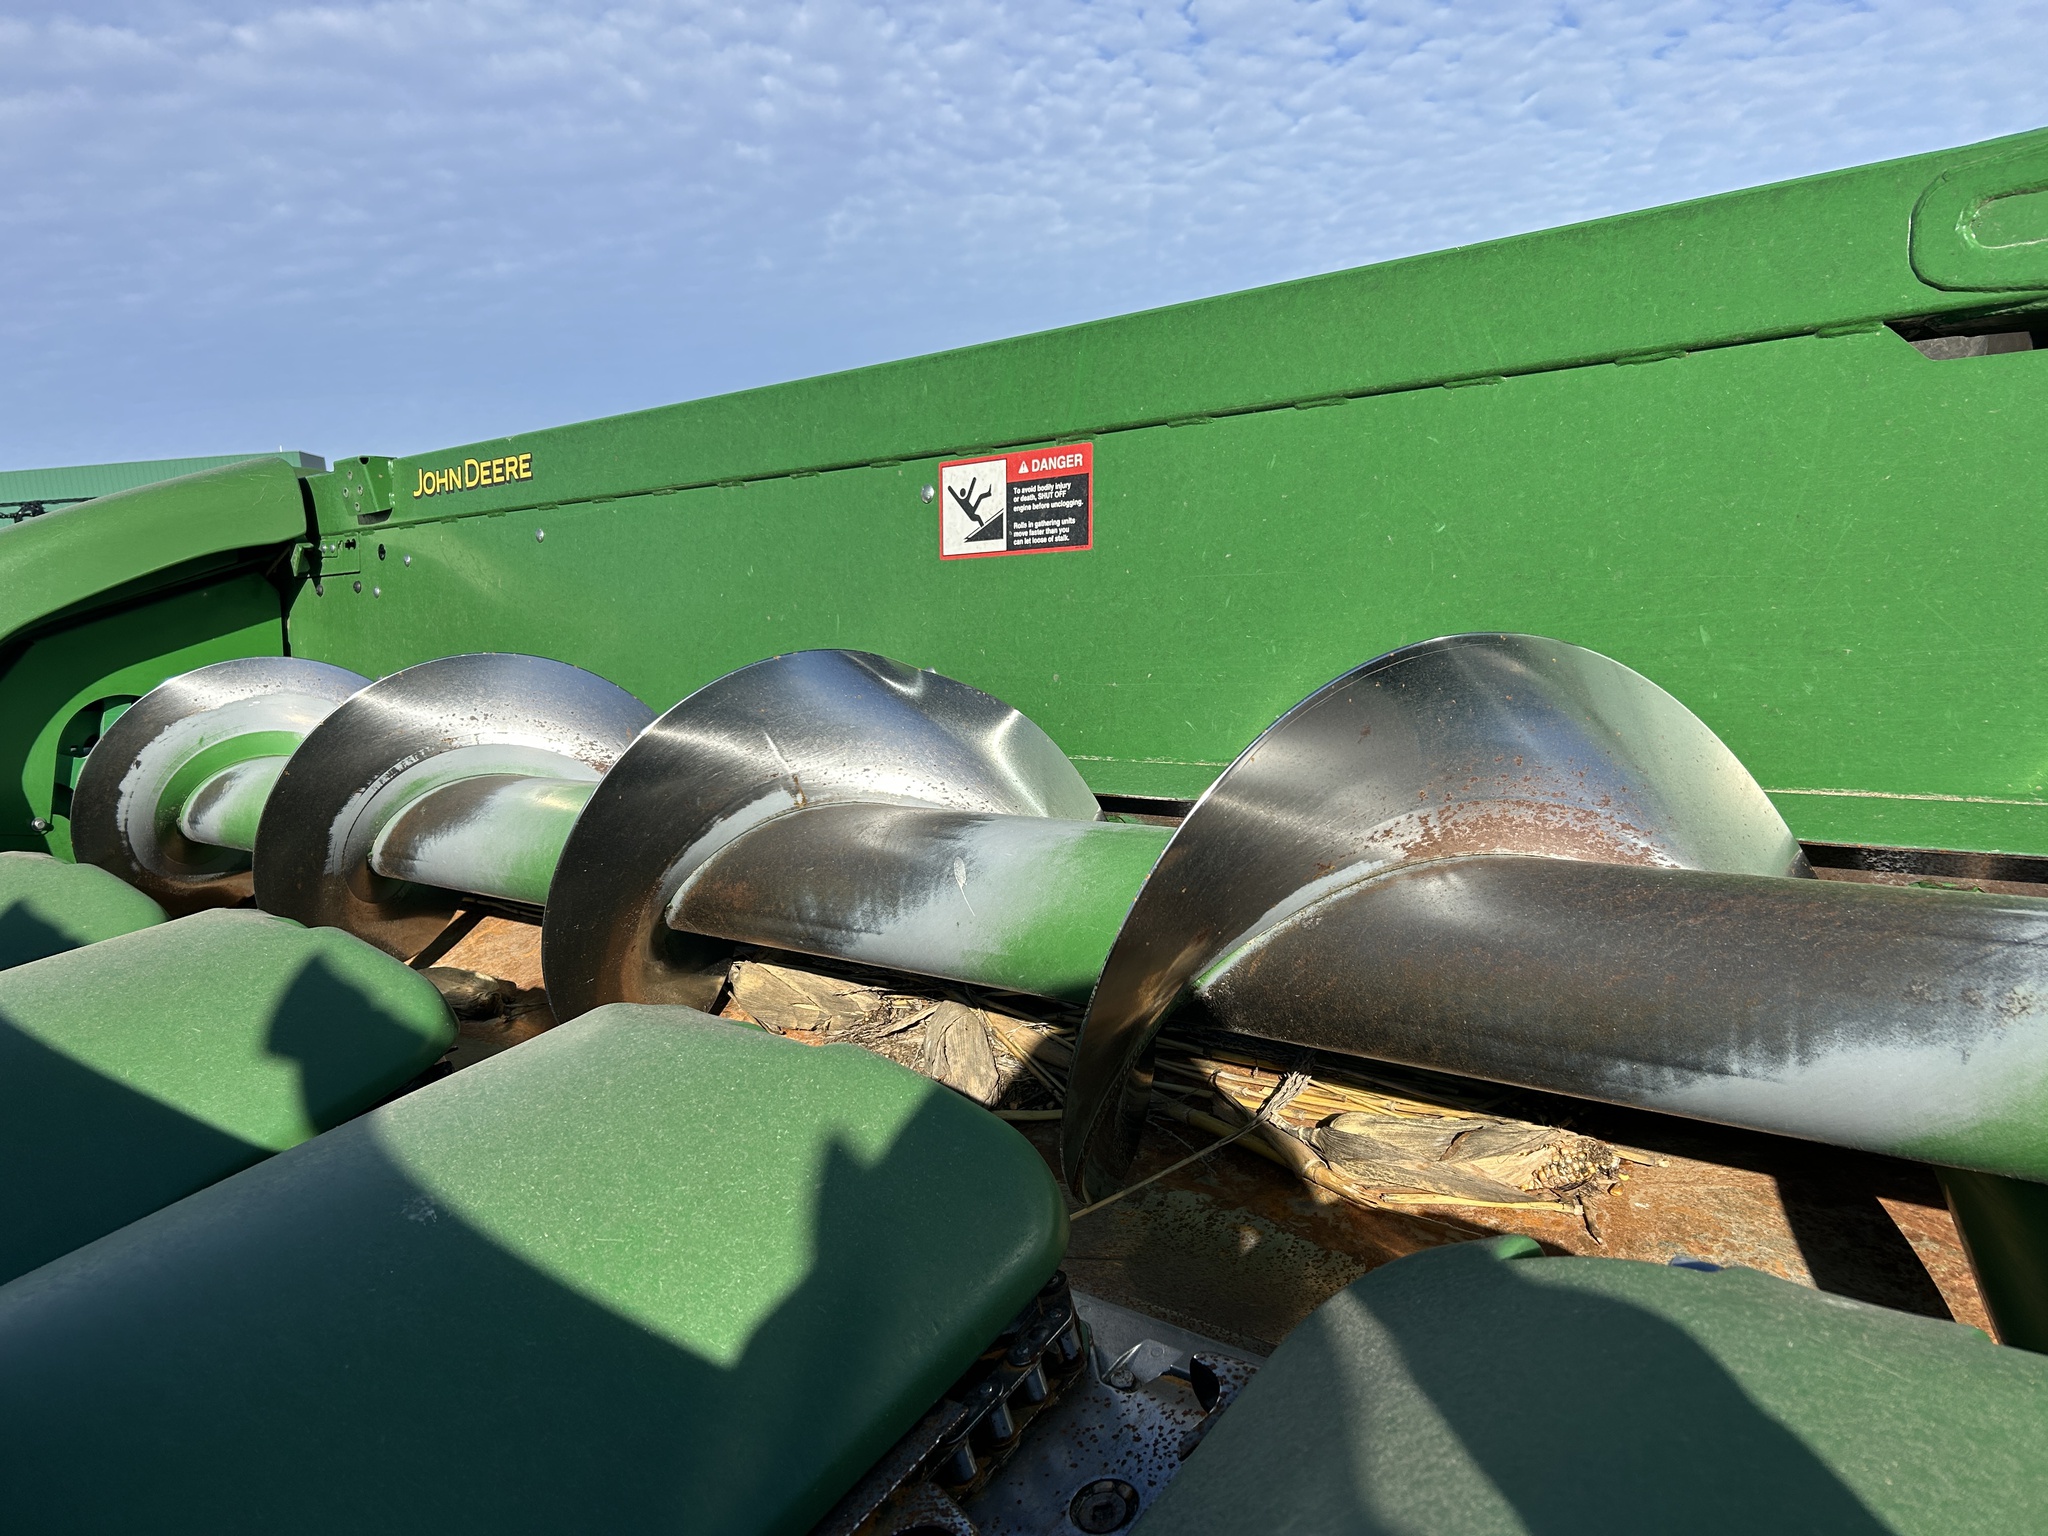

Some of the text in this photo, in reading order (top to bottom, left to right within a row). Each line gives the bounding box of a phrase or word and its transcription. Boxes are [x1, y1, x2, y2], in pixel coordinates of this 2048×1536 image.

[1032, 454, 1083, 472] DANGER
[413, 453, 532, 497] JOHN DEERE
[1037, 483, 1054, 492] bodily
[1055, 482, 1071, 490] injury
[1020, 494, 1037, 502] death,
[1038, 492, 1053, 500] SHUT
[1055, 490, 1066, 498] OFF
[1013, 504, 1031, 513] engine
[1051, 499, 1083, 508] unclogging.
[1035, 518, 1060, 528] gathering
[1061, 517, 1075, 525] units
